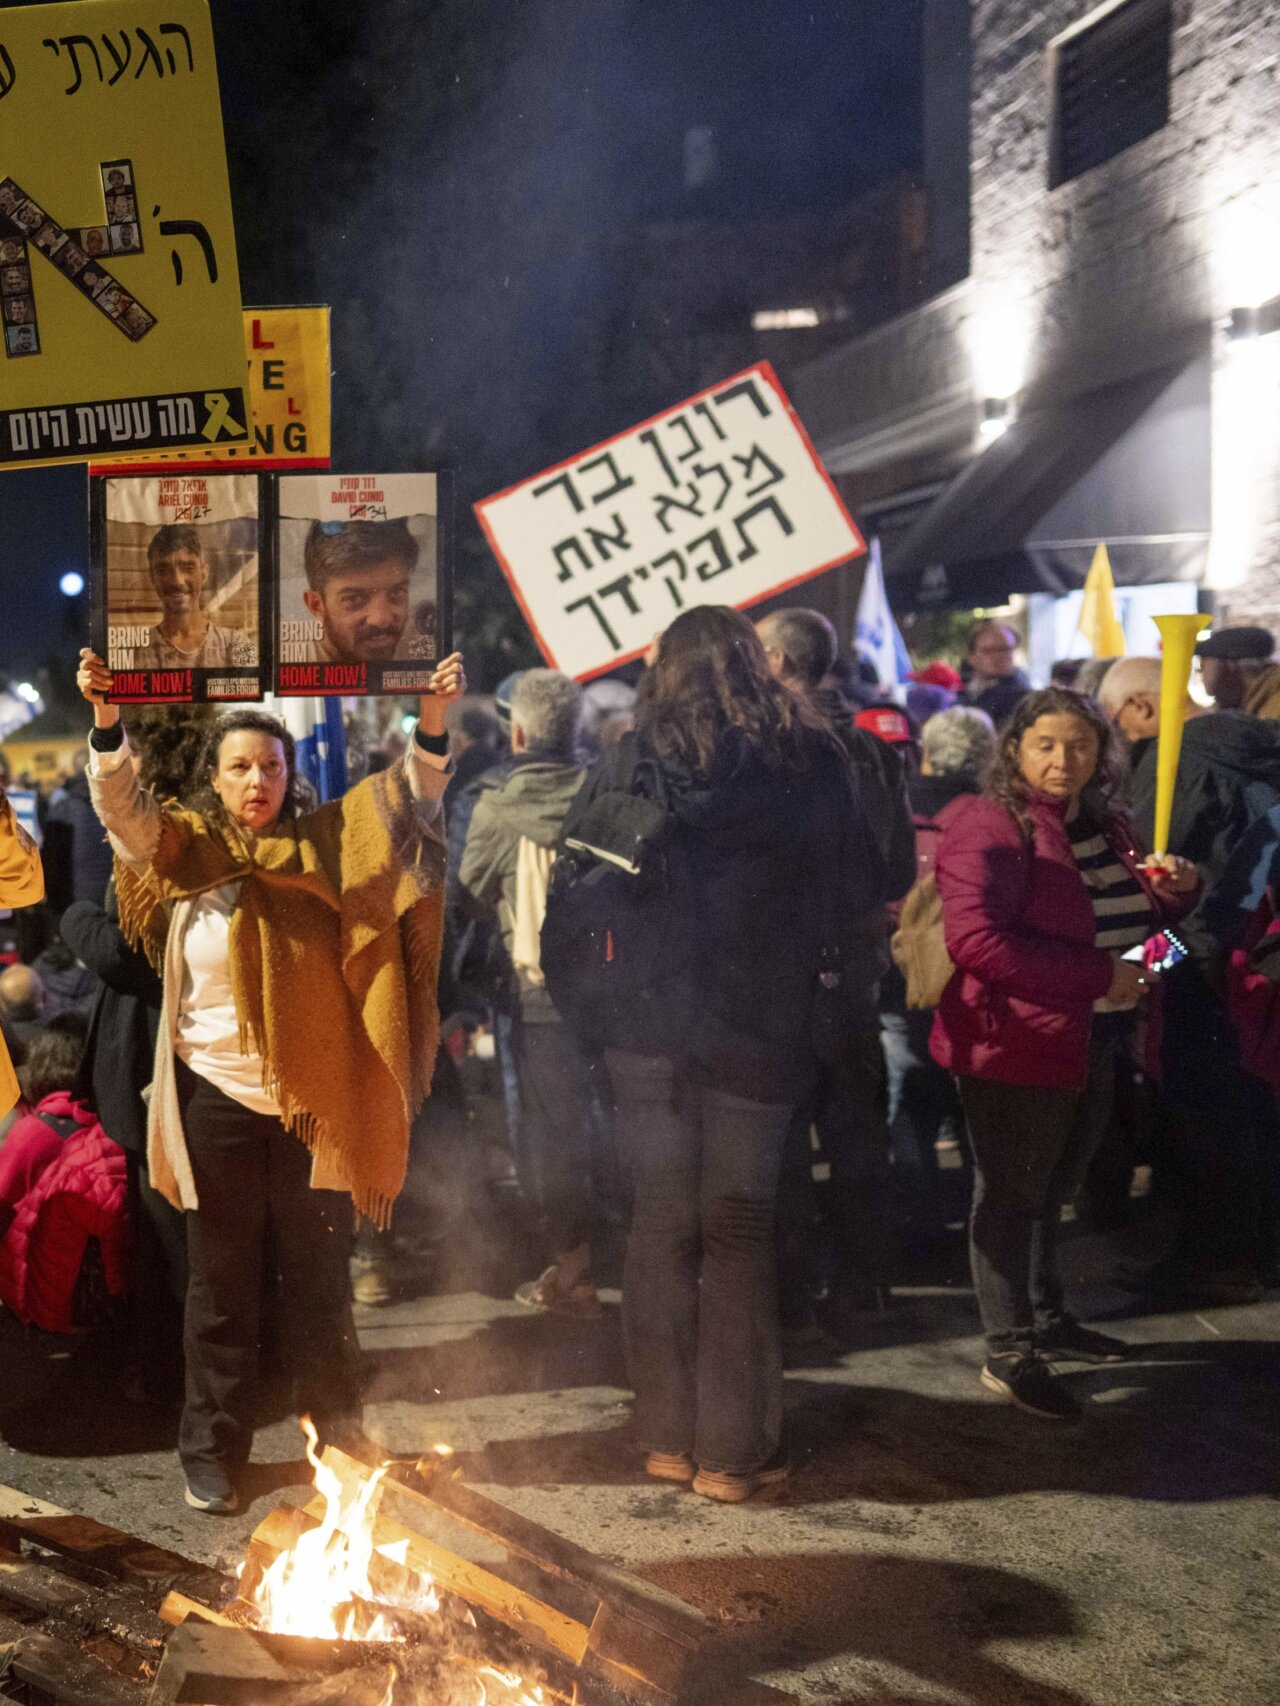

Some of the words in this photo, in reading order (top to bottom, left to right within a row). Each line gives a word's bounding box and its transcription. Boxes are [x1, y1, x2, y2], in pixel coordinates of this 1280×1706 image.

[43, 22, 194, 96] הגעתי
[76, 401, 153, 446] עשית
[158, 397, 196, 437] מה
[9, 408, 70, 452] היום
[639, 378, 772, 488] רונן
[532, 452, 635, 514] בר
[653, 442, 786, 534] מלא
[159, 494, 181, 506] ARIEL
[183, 493, 208, 506] CUNIO
[331, 491, 356, 503] DAVID
[359, 490, 384, 503] CUNIO
[551, 513, 634, 583] את
[564, 495, 795, 651] תפקידך
[108, 626, 150, 648] BRING
[280, 621, 324, 642] BRING
[108, 649, 135, 670] HIM
[280, 642, 308, 662] HIM
[108, 673, 148, 694] HOME
[151, 670, 192, 693] NOW!
[279, 666, 320, 688] HOME
[324, 663, 368, 686] NOW!
[383, 678, 412, 688] FAMILIES
[207, 685, 236, 695] FAMILIES
[237, 684, 260, 694] FORUM
